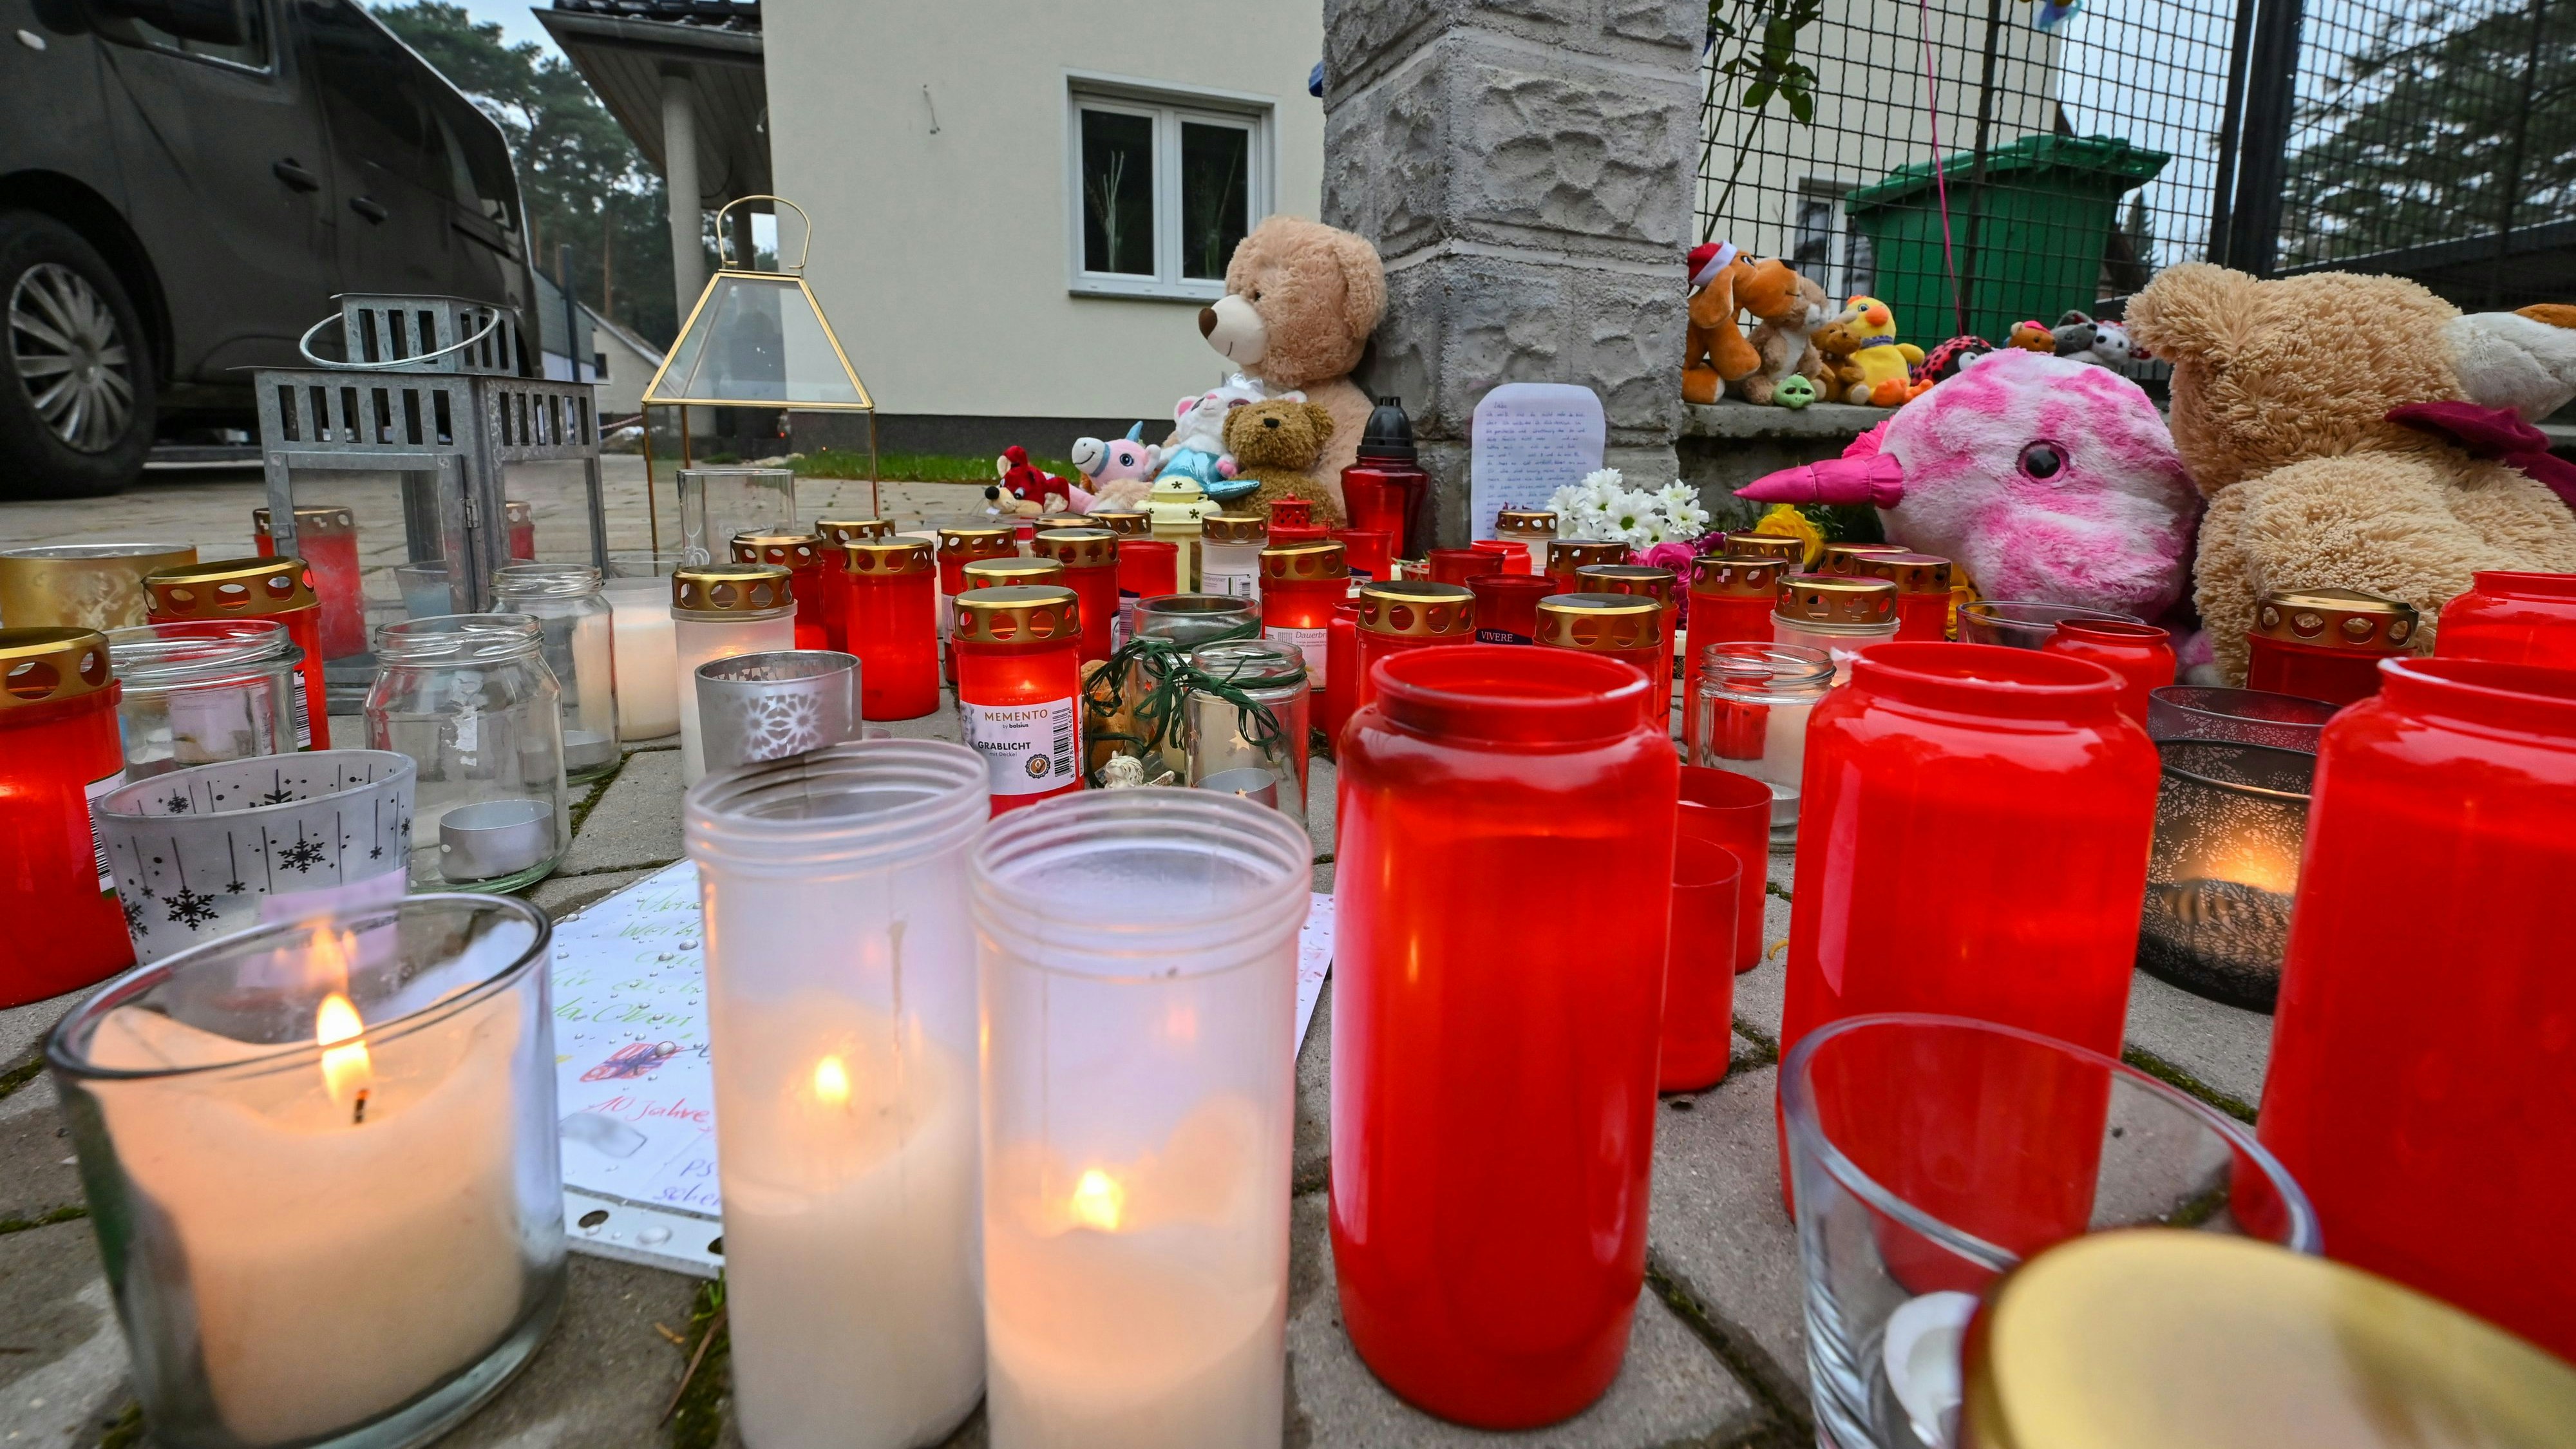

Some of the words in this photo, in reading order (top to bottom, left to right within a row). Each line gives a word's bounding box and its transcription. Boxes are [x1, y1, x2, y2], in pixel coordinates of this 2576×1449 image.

[1481, 630, 1513, 642] VIVERE
[985, 709, 1048, 721] MEMENTO
[978, 741, 1030, 750] GRABLICHT
[582, 1095, 636, 1113] 10
[625, 1097, 711, 1122] Jahre
